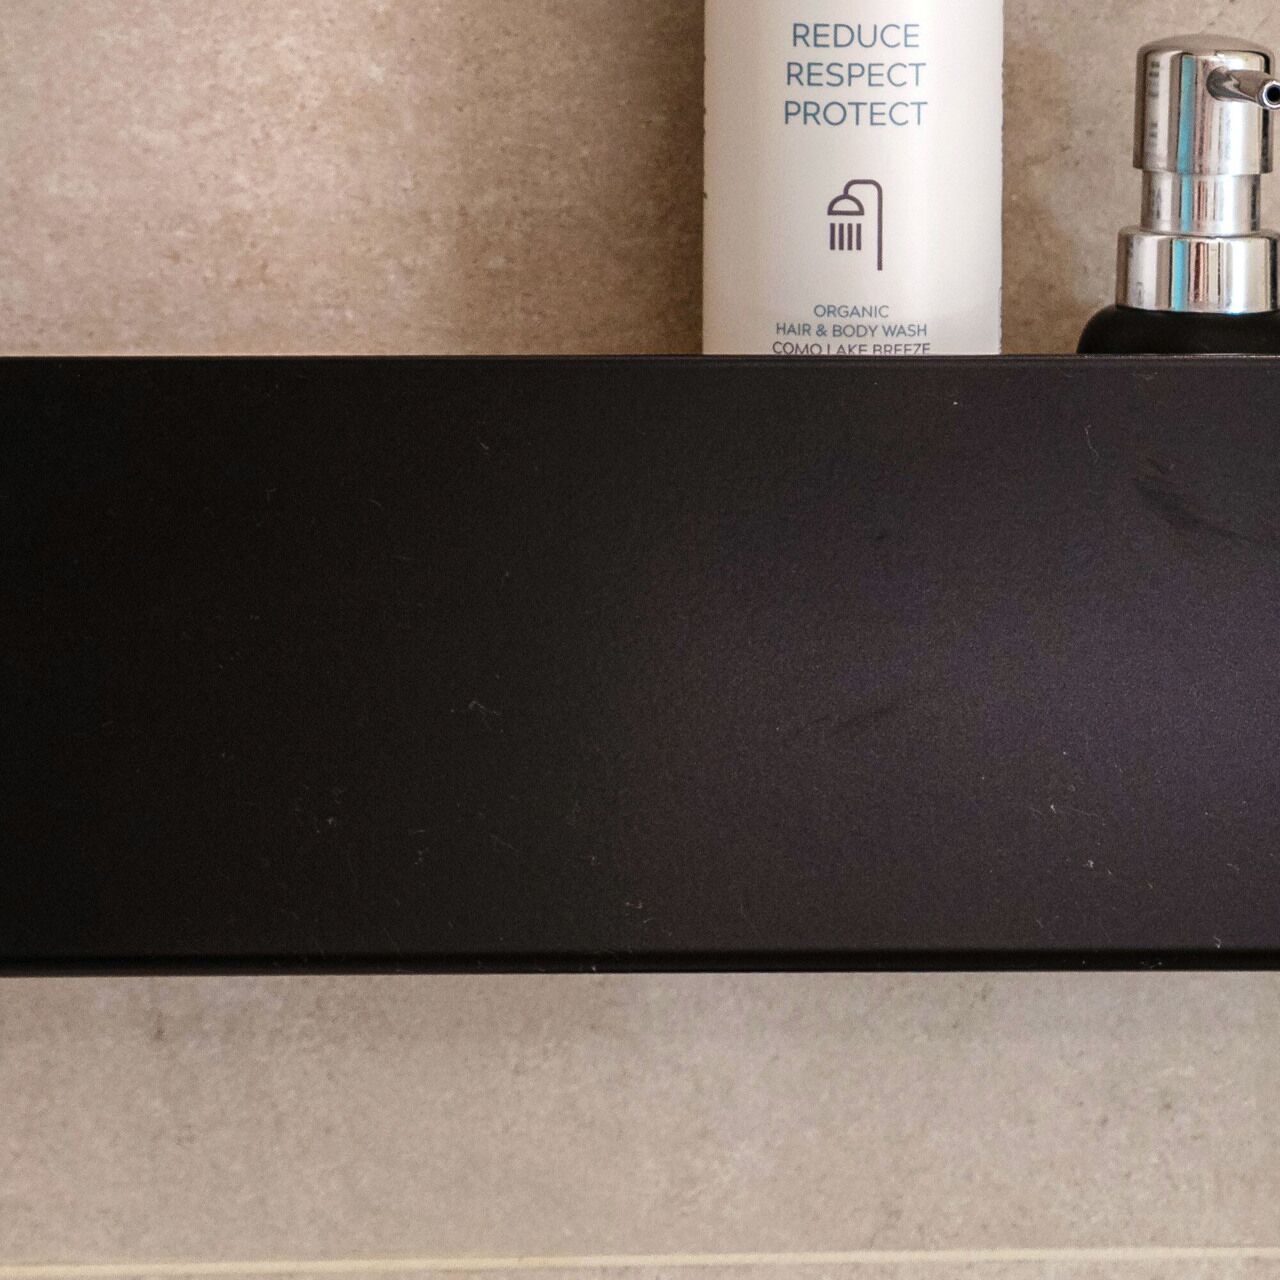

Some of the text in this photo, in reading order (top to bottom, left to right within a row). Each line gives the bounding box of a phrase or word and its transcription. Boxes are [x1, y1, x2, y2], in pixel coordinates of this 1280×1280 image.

[792, 22, 920, 48] REDUCE
[786, 62, 927, 87] RESPECT
[784, 101, 928, 126] PROTECT
[813, 304, 890, 318] ORGANIC
[776, 322, 927, 338] HAIR & BODY WASH
[772, 341, 823, 355] COMO
